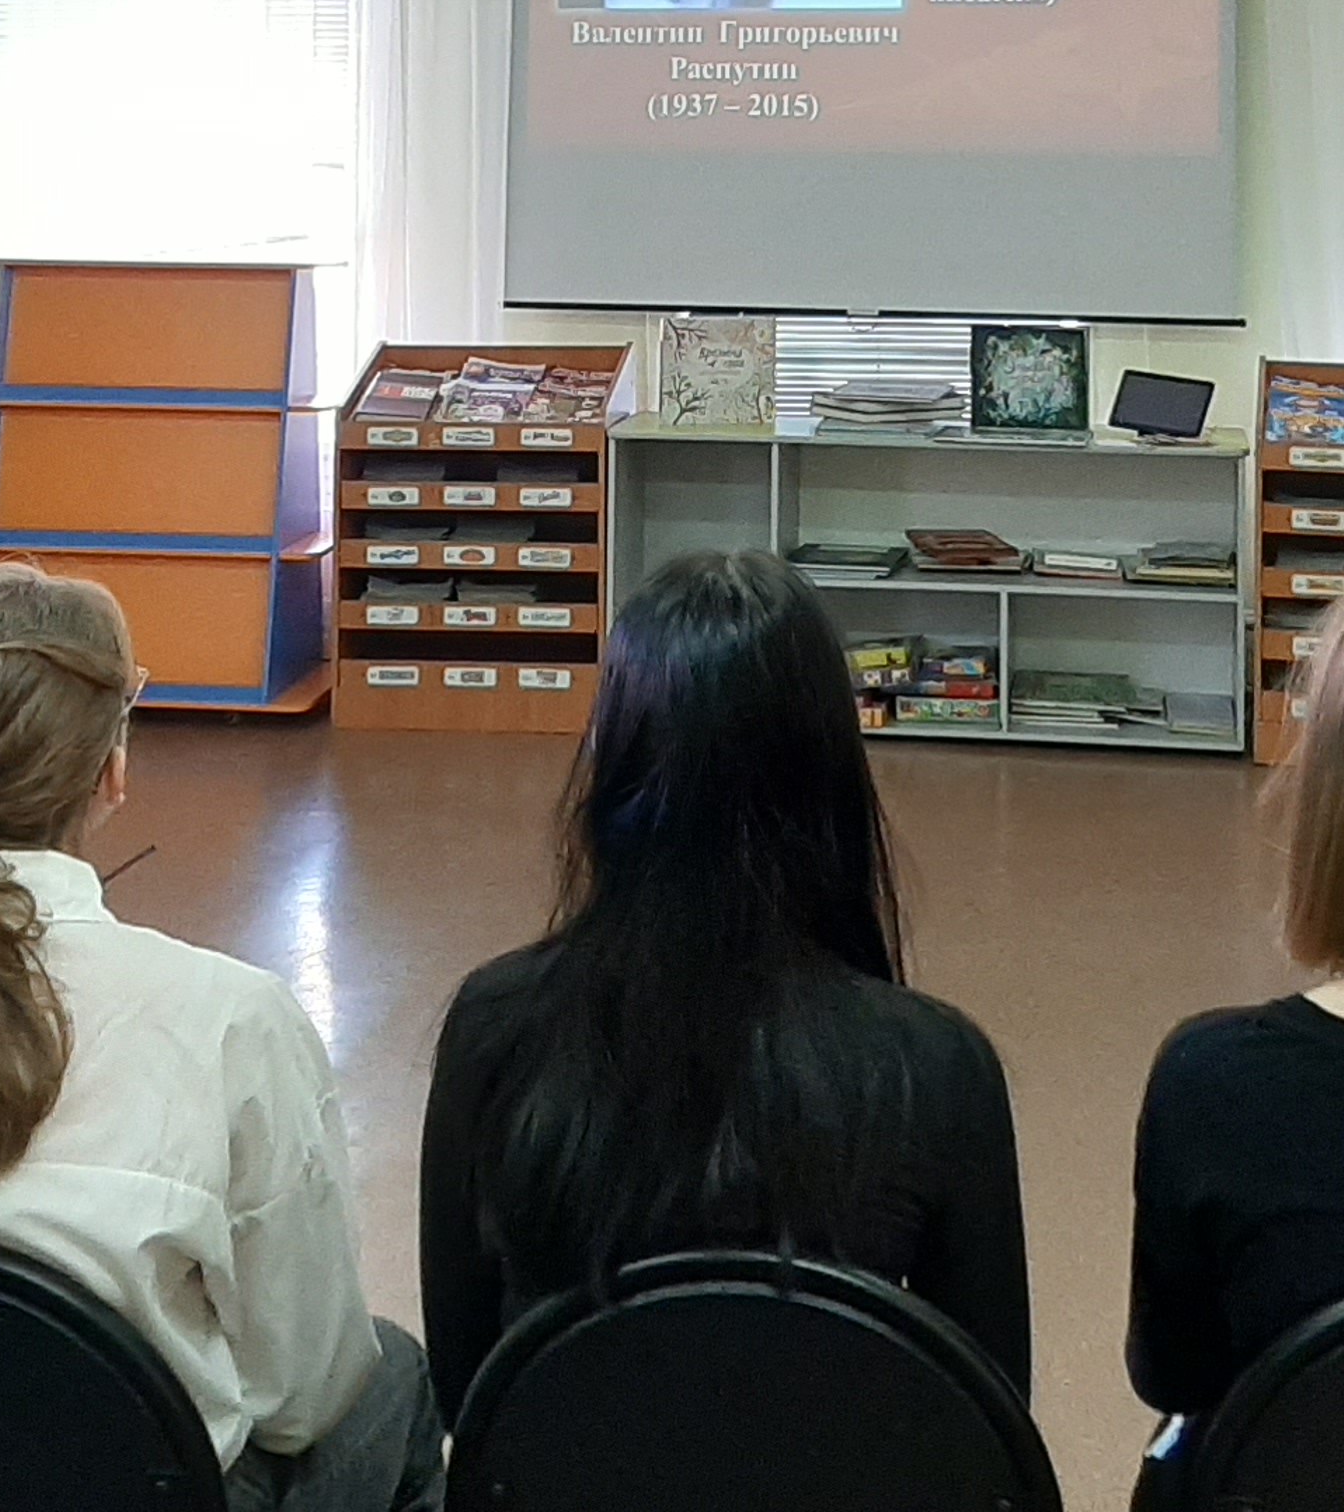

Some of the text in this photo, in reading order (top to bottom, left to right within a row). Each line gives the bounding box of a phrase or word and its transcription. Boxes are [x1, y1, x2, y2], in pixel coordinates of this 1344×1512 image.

[571, 19, 900, 51] Валентин Григорьевич
[670, 56, 798, 85] Распутин
[647, 92, 719, 121] (1937
[747, 92, 820, 121] 2015)
